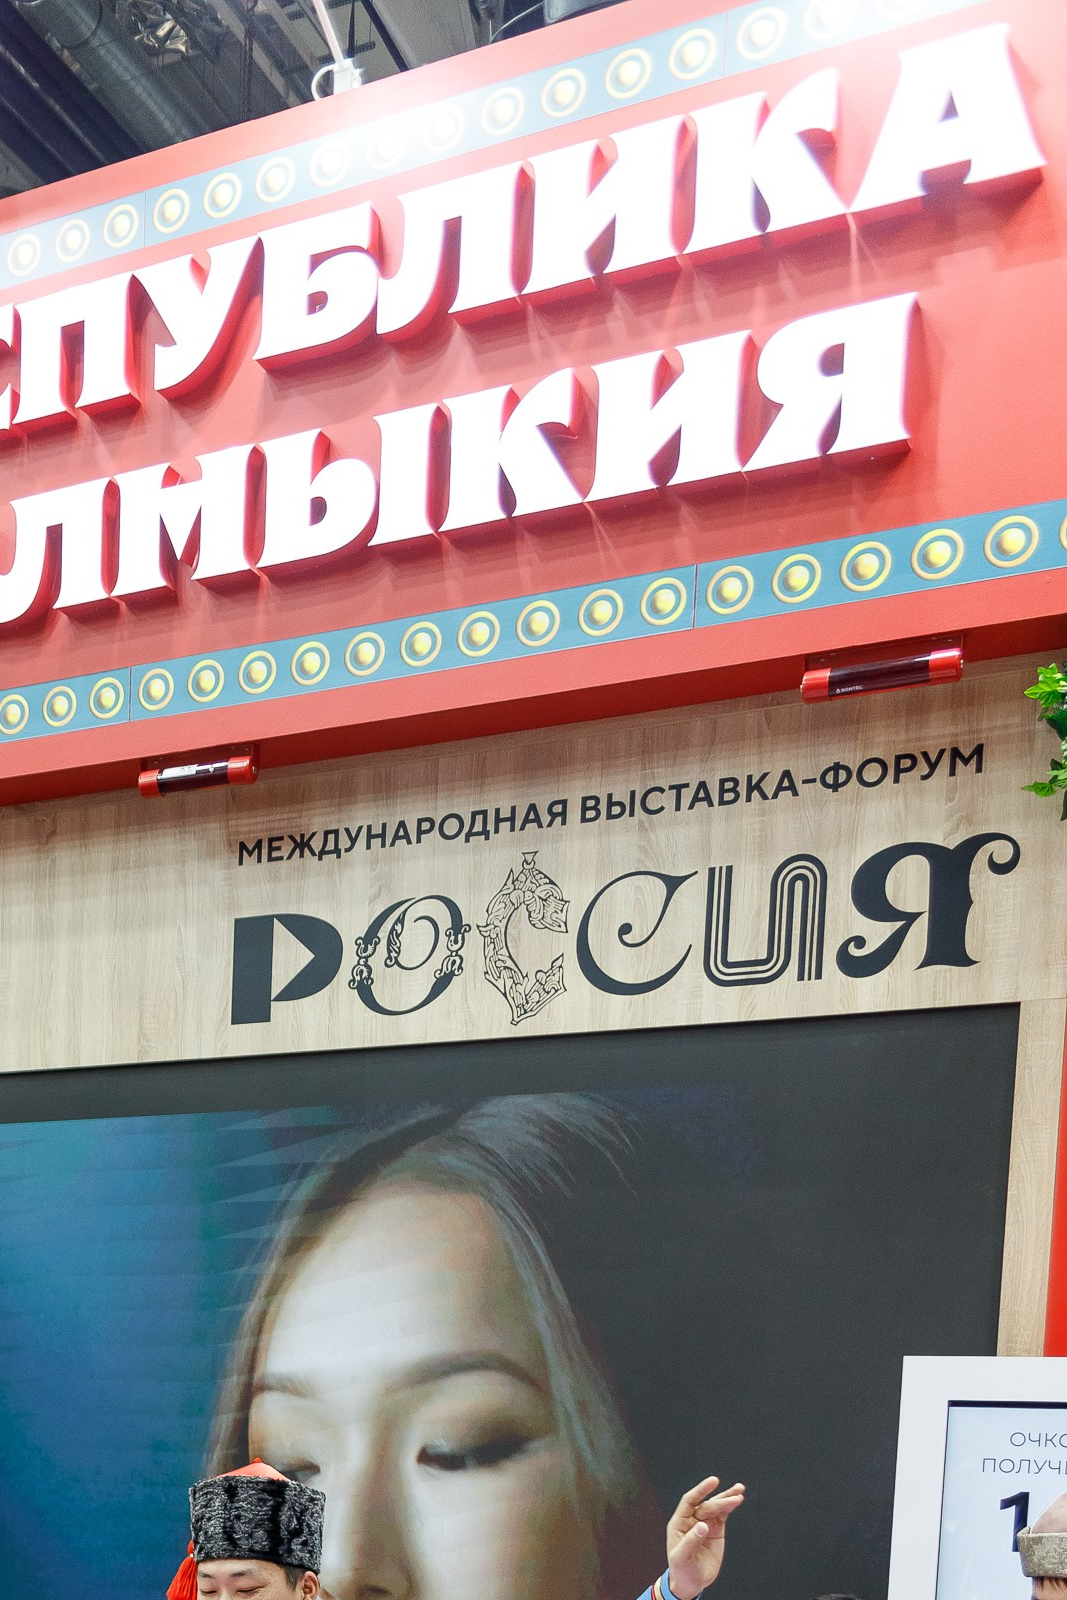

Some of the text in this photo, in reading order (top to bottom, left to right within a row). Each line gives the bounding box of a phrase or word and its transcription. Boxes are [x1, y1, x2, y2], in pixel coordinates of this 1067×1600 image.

[238, 743, 985, 866] МЕЖДУНАРОДНАЯ ВЫСТАВКА-ФОРУМ
[231, 831, 1021, 1027] РОССИЯ
[982, 1457, 1067, 1476] ПОЛУЧ
